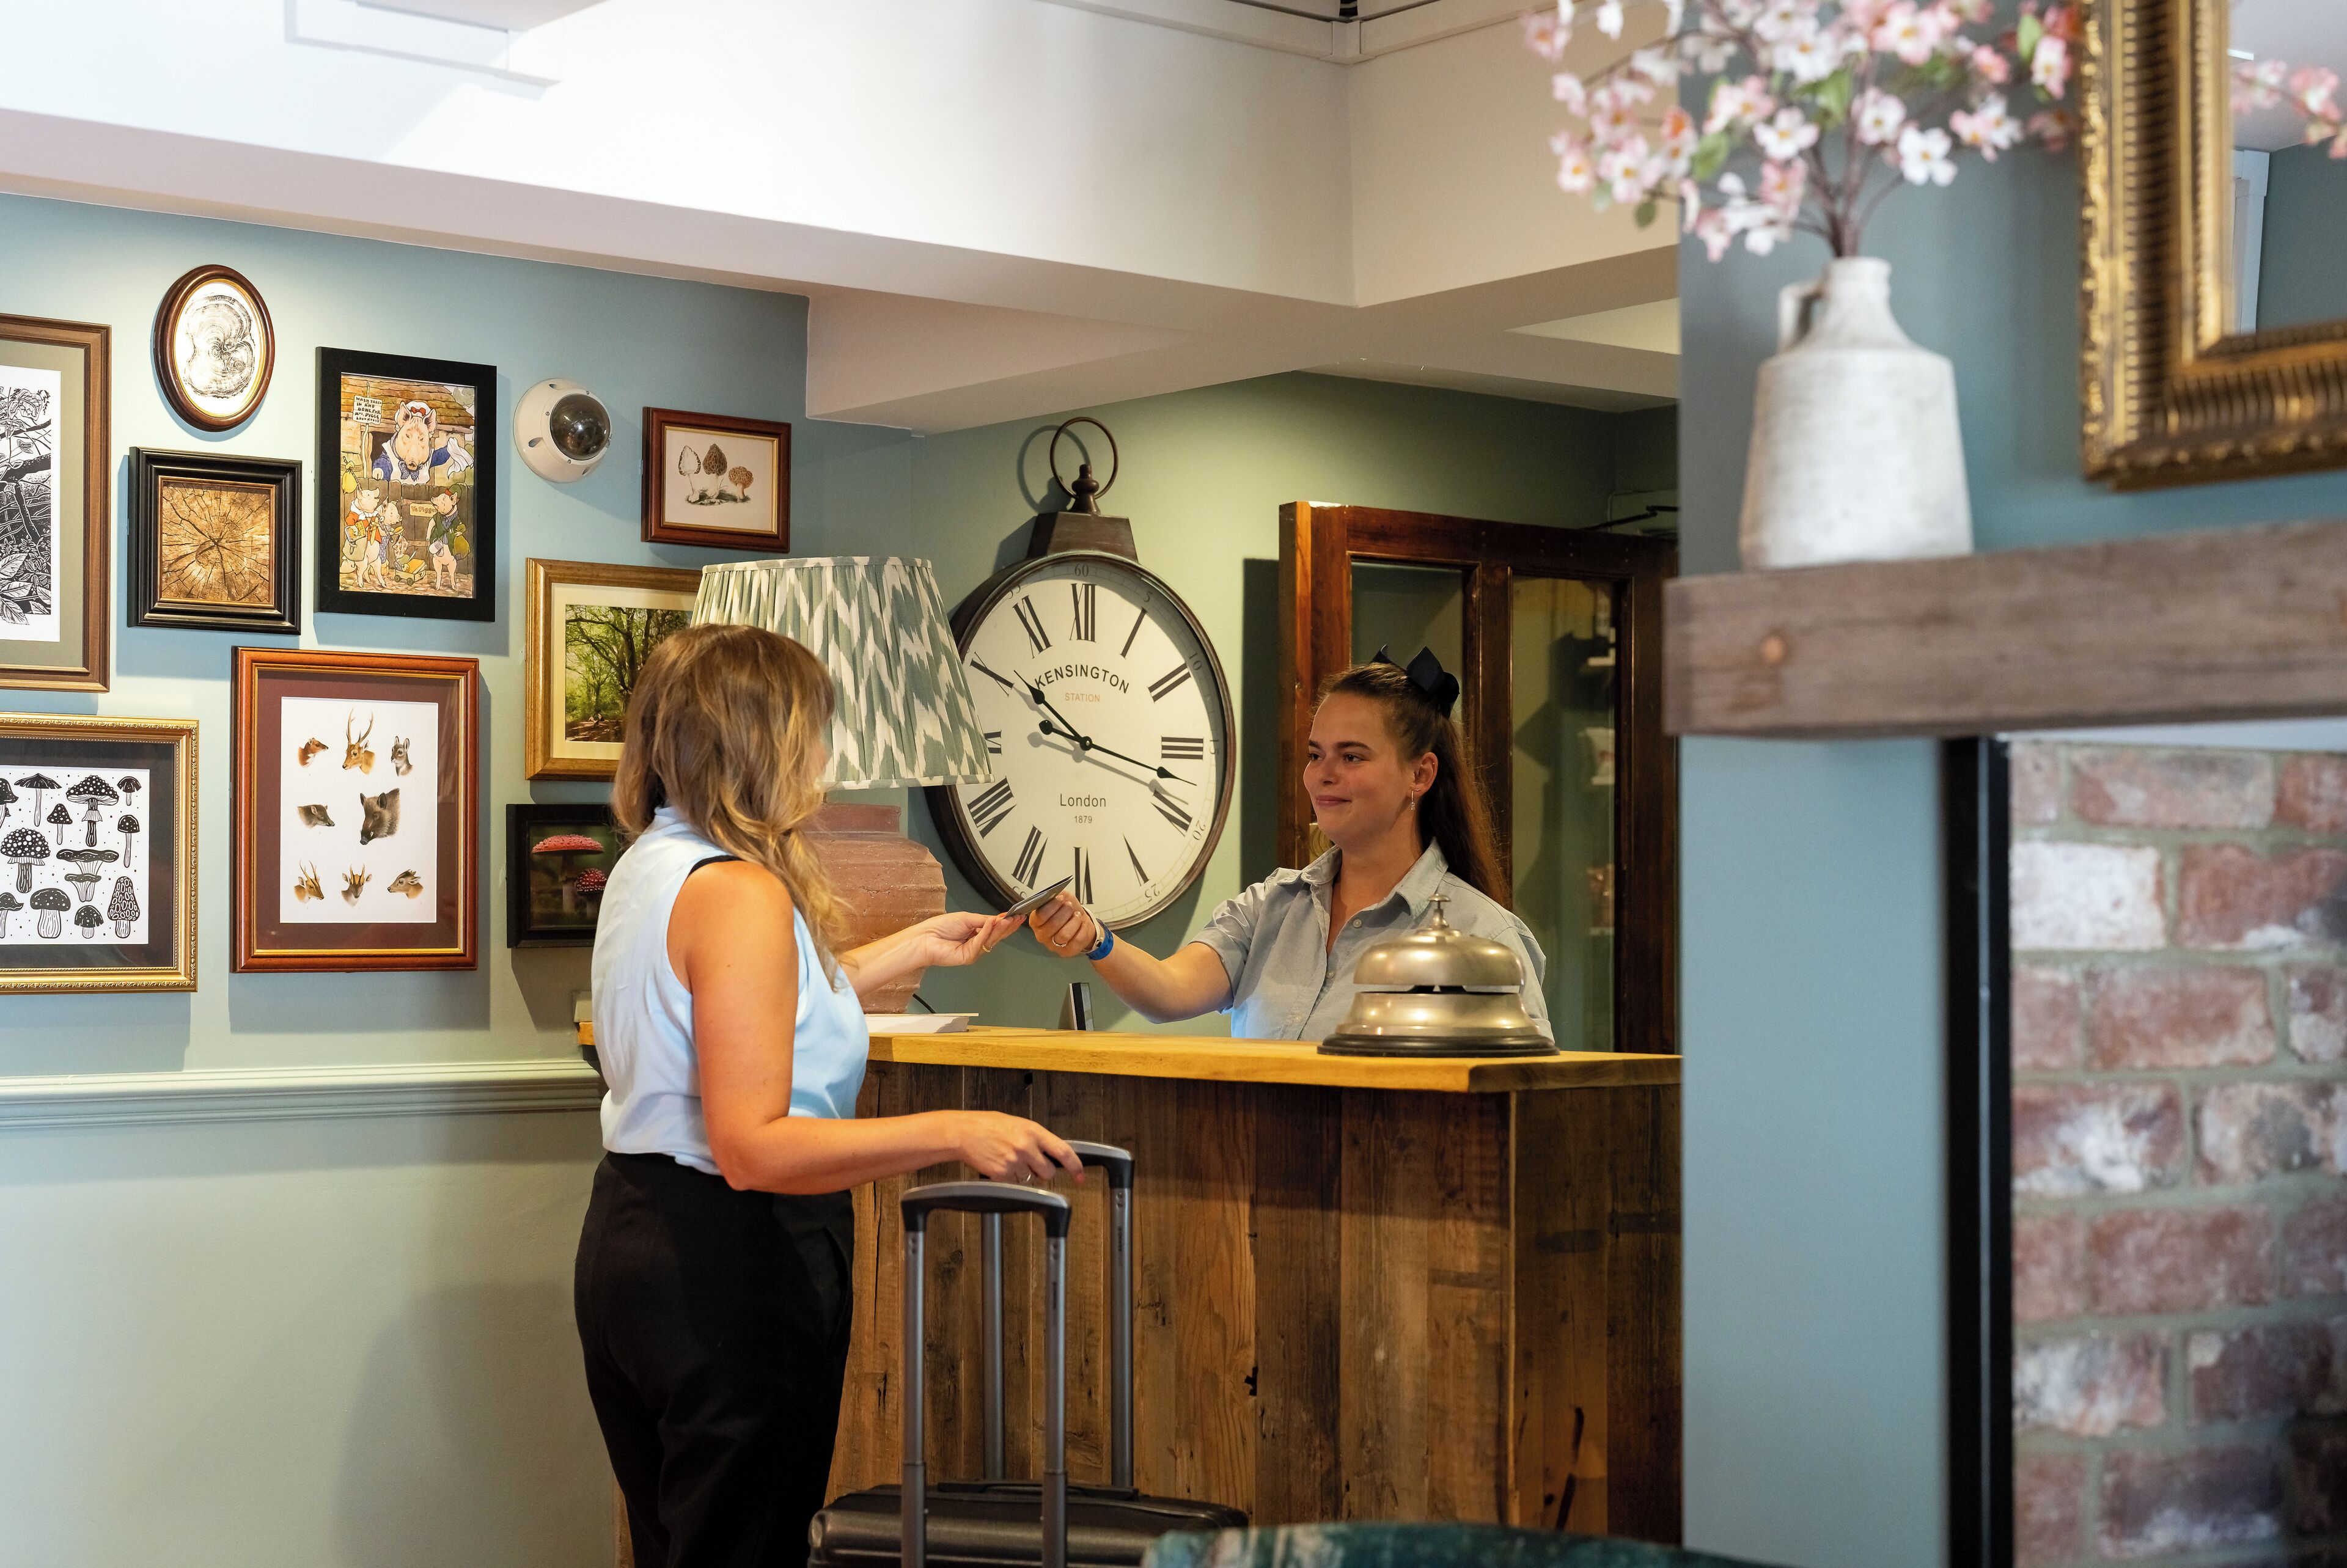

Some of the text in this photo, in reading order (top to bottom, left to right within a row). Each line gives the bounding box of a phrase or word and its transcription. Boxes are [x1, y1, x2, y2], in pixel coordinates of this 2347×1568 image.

[1074, 563, 1089, 577] 60
[1069, 583, 1096, 643] XII
[1144, 591, 1153, 603] 5
[1012, 595, 1052, 659] XI
[1120, 607, 1148, 659] I
[970, 651, 1015, 697] X
[1034, 664, 1129, 694] KENSINGTON
[1189, 652, 1203, 670] 10
[1065, 692, 1100, 702] STATION
[1147, 662, 1192, 704] II
[1161, 735, 1203, 761] III
[967, 775, 1017, 840] VIII
[1060, 793, 1106, 807] London
[1150, 788, 1192, 837] IV
[1074, 815, 1092, 824] 1879
[1192, 819, 1207, 841] 20
[1011, 824, 1048, 890] VII
[1073, 846, 1093, 904] VI
[1123, 835, 1149, 886] V
[1145, 884, 1160, 903] 25
